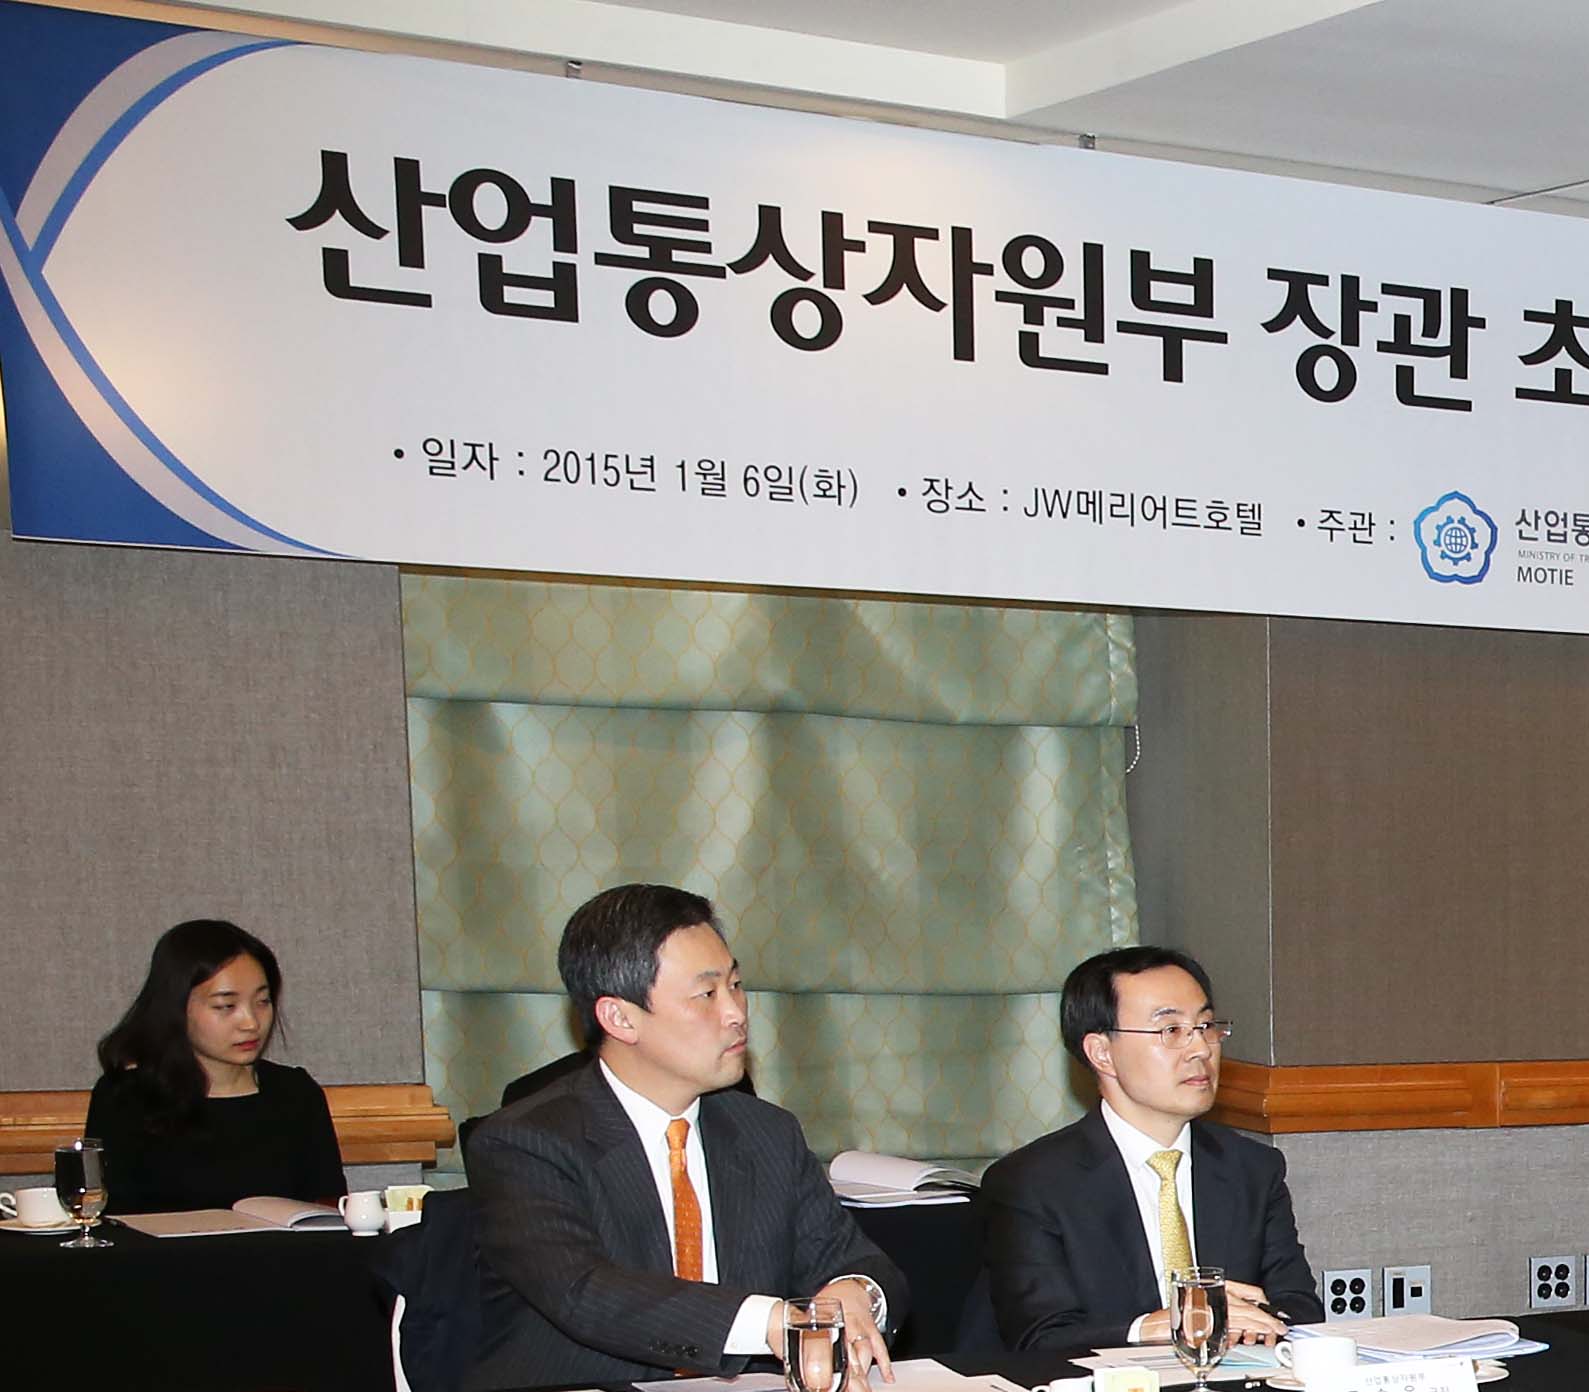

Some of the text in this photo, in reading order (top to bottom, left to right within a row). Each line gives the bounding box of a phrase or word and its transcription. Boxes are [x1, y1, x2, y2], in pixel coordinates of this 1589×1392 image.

[284, 149, 1229, 384] 산업통상자원부
[1260, 267, 1487, 413] 장관
[422, 437, 500, 481] 일자
[543, 448, 657, 492] 2015년
[675, 458, 727, 498] 1월
[743, 464, 858, 508] 6일(화)
[921, 477, 987, 514] 장소
[1023, 487, 1262, 537] JW메리어트호텔
[1316, 509, 1377, 545] 주관
[1517, 565, 1574, 586] MOTIE
[1518, 549, 1561, 563] MINISTRY
[1563, 552, 1575, 564] OF
